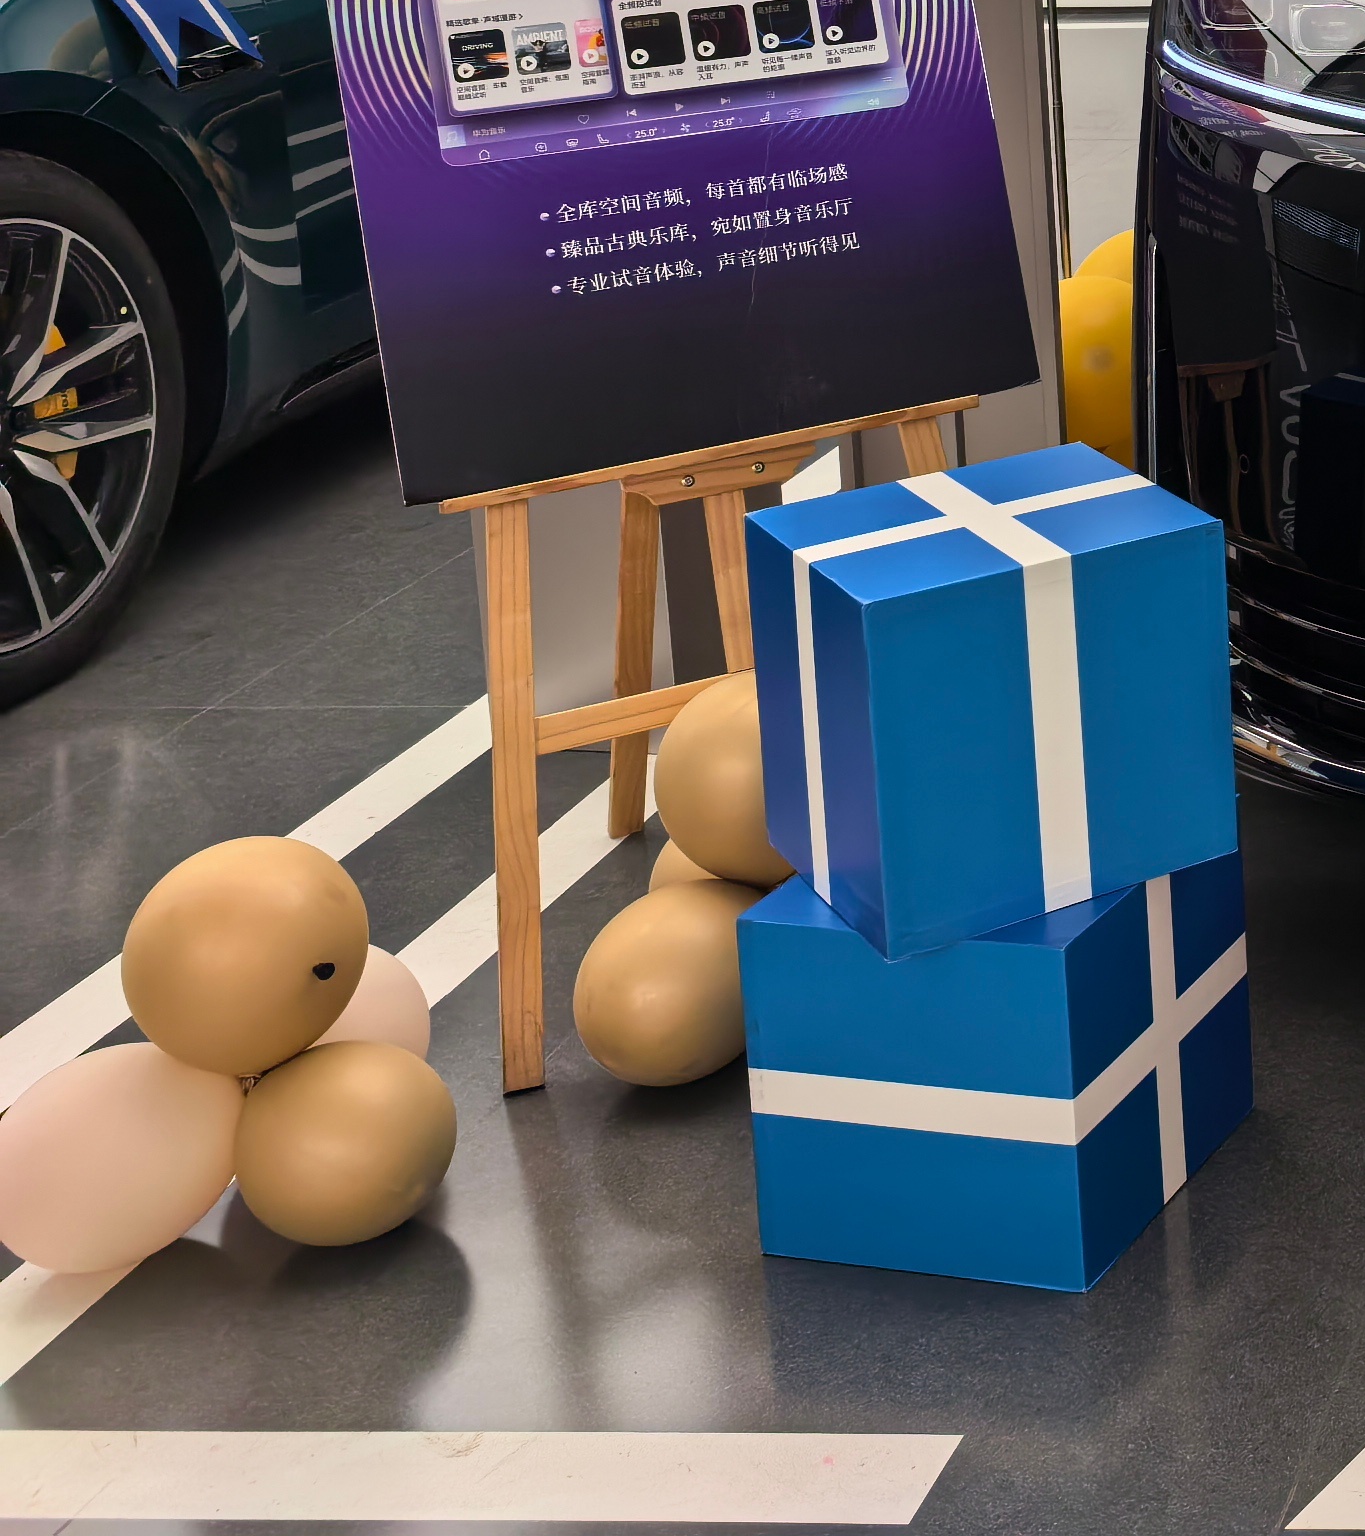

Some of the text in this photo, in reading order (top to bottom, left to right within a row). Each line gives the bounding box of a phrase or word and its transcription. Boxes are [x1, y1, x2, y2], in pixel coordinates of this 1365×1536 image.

[461, 41, 494, 52] DRIVING
[556, 162, 849, 224] 全库空间音频，每首都有临场感
[560, 197, 853, 260] 臻品古典乐库，宛如置身音乐厅
[566, 231, 861, 296] 专业试音体验，声音细节听得见
